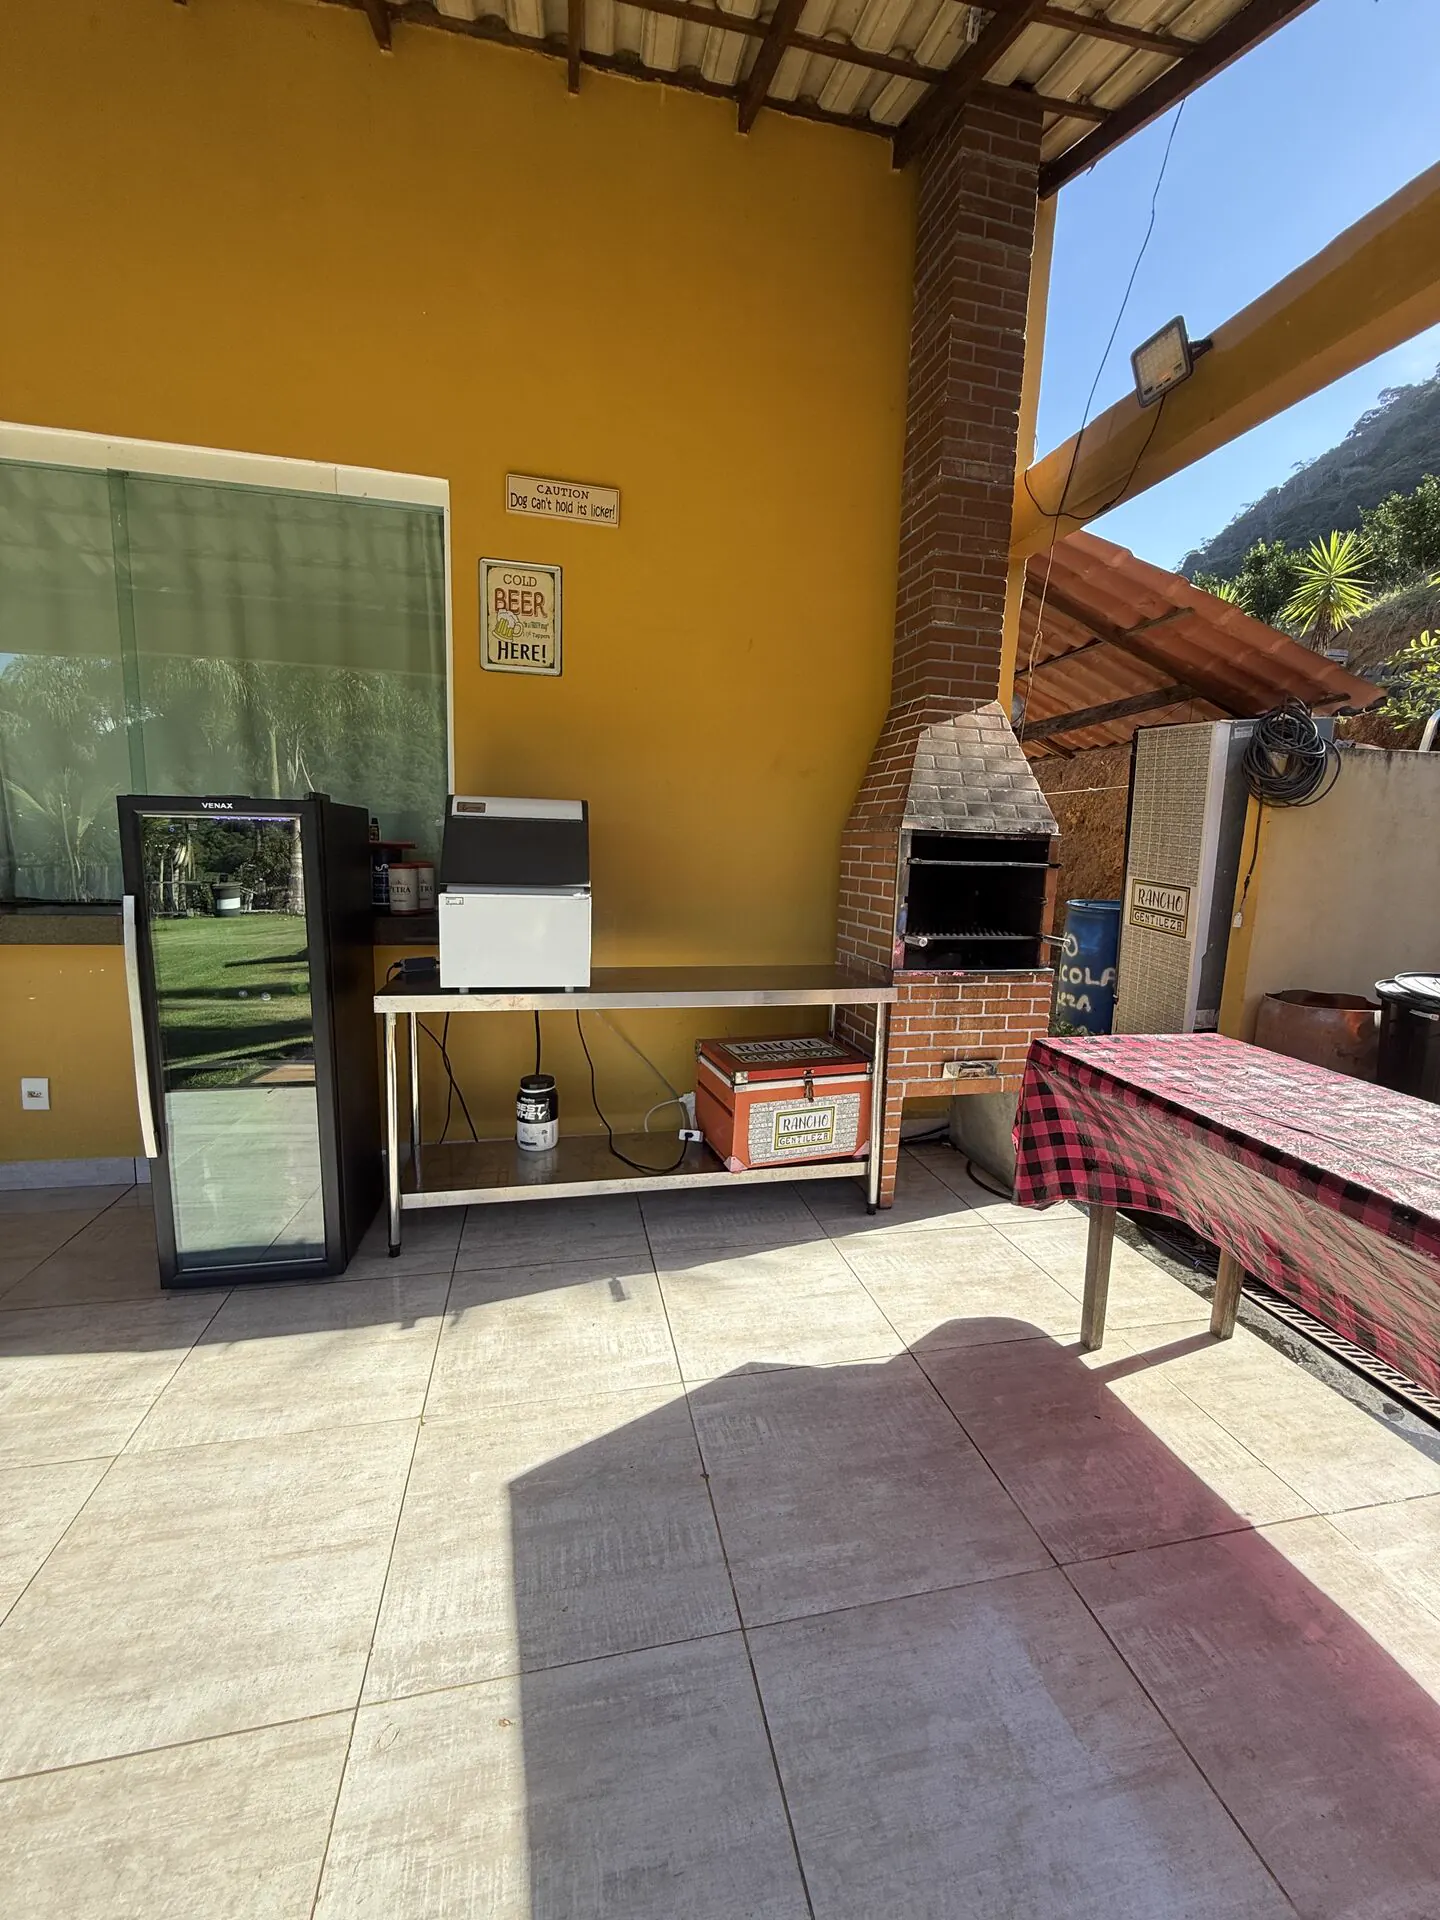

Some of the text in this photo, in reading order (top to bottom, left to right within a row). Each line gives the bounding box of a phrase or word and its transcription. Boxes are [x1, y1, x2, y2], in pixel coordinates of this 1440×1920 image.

[536, 484, 590, 499] CAUTION
[510, 492, 528, 509] Dog
[555, 499, 573, 514] hold
[577, 501, 587, 515] its
[590, 503, 616, 519] licker!
[503, 573, 537, 587] COLD
[494, 587, 548, 618] BEER
[498, 640, 546, 664] HERE!
[1138, 887, 1183, 912] RANCHO
[1134, 911, 1182, 931] GENTILEZA
[735, 1040, 823, 1053] RANCHO
[783, 1114, 829, 1131] RANCHO
[779, 1132, 828, 1145] GENTILEZA
